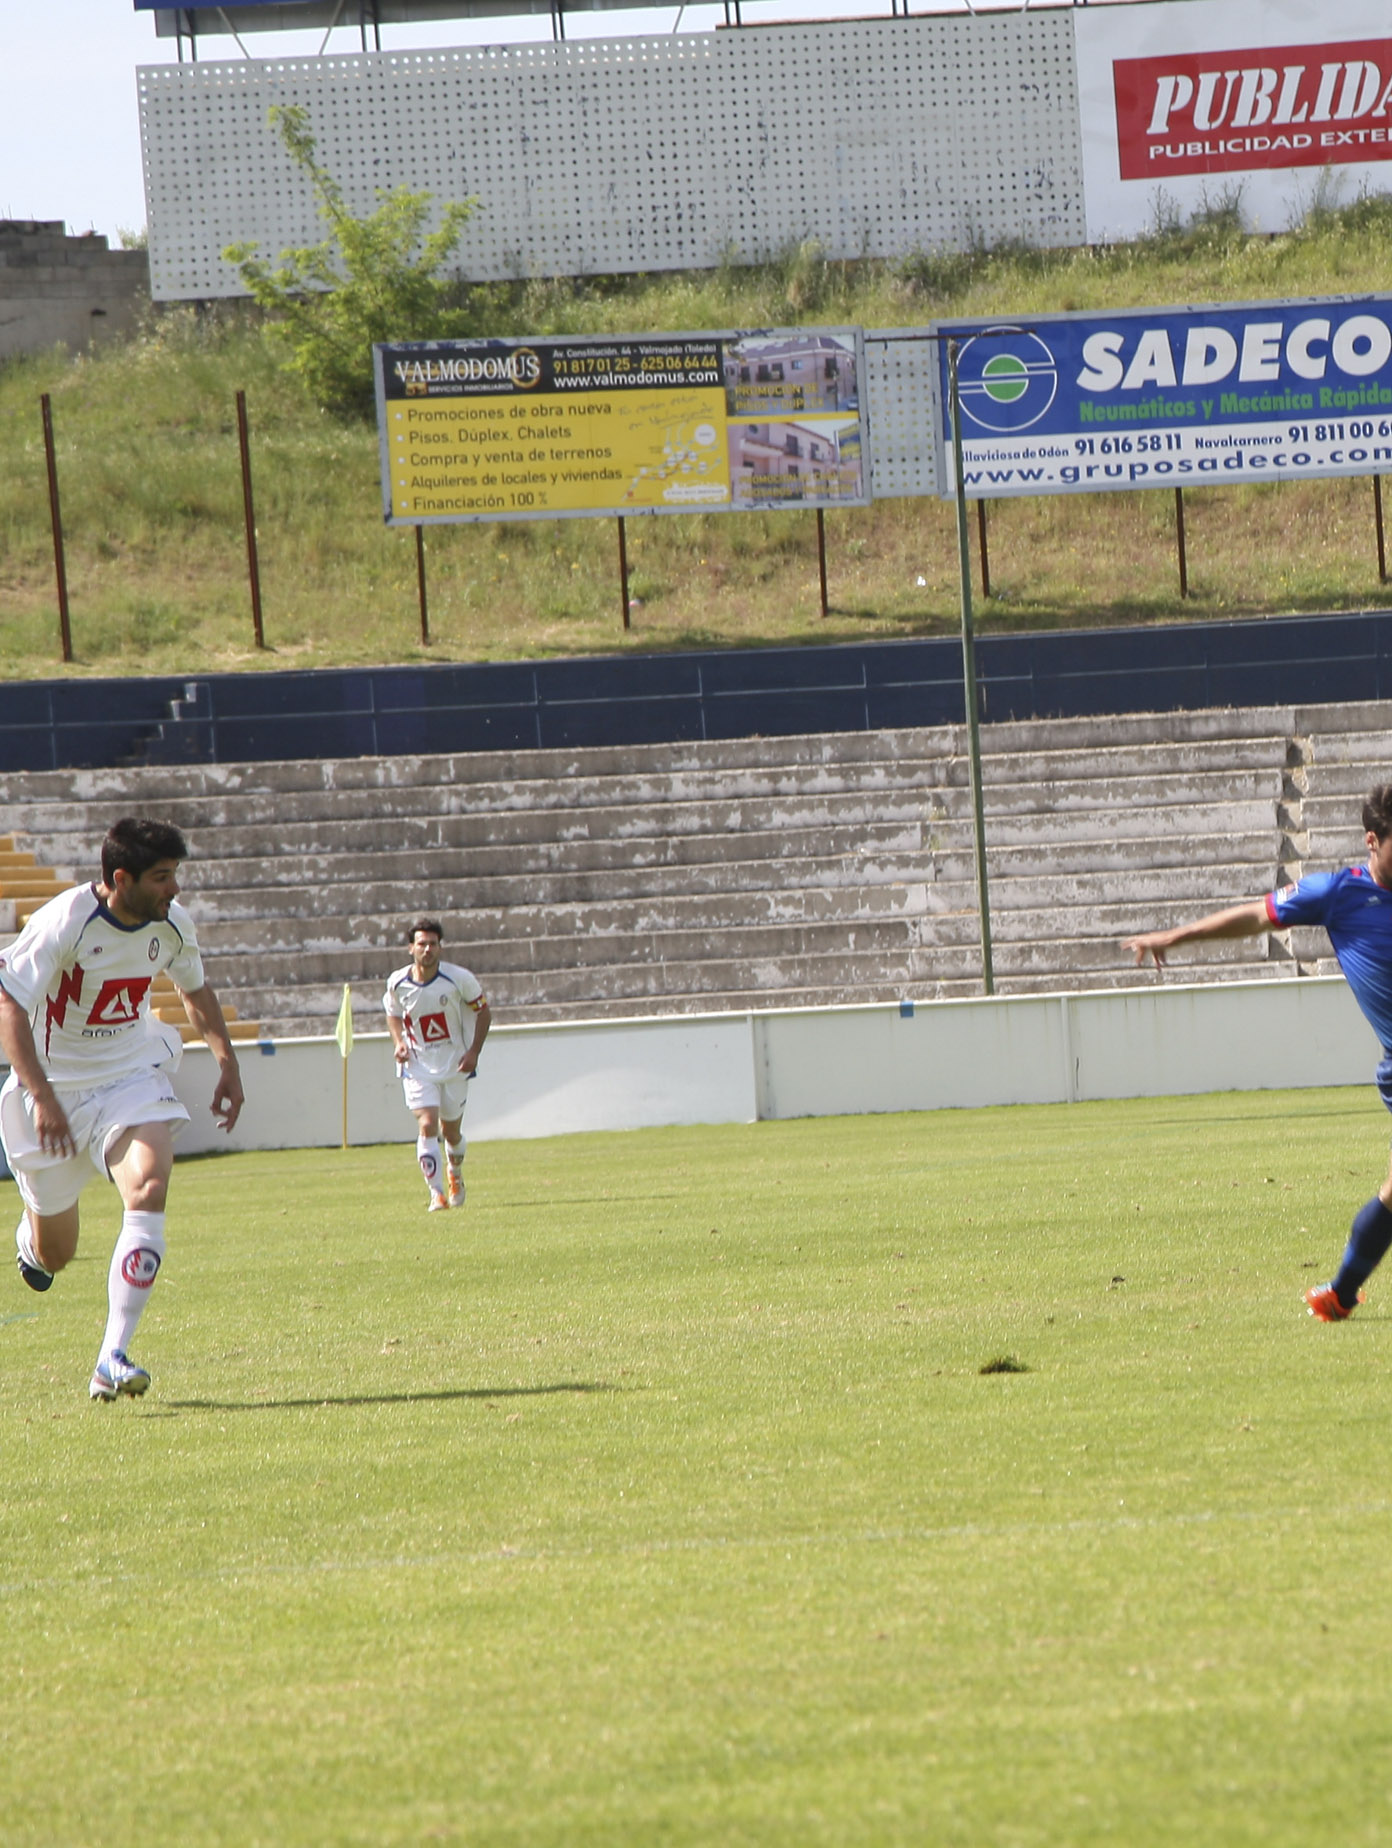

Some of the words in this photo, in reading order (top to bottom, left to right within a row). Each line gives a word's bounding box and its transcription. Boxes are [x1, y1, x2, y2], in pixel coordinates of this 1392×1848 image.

[1149, 134, 1312, 160] PUBLICIDAD
[553, 360, 568, 374] 91
[571, 358, 595, 373] 817
[596, 358, 611, 373] 01
[614, 357, 631, 372] 25
[641, 356, 665, 371] 625
[666, 355, 682, 371] 06
[684, 355, 700, 369] 64
[701, 354, 717, 368] 44
[1075, 314, 1392, 393] SADECO
[396, 355, 541, 383] VALMODOMUS
[553, 370, 718, 388] www.valmodomus.com
[408, 407, 504, 422] Promociones
[509, 405, 526, 419] de
[531, 404, 563, 418] obra
[568, 402, 611, 416] nueva
[1079, 396, 1196, 423] Neumáticos
[1201, 398, 1214, 420] y
[1220, 389, 1314, 415] Mecánica
[1319, 381, 1392, 410] Rápida
[518, 425, 572, 440] Chalets
[1022, 448, 1036, 460] de
[1038, 445, 1069, 459] Odón
[1074, 438, 1095, 456] 91
[1100, 436, 1133, 455] 616
[1137, 434, 1162, 453] 58
[1167, 433, 1182, 451] 11
[1195, 435, 1282, 449] Navalcarnero
[1288, 425, 1309, 443] 91
[1315, 423, 1344, 442] 811
[1349, 421, 1374, 439] 00
[410, 452, 468, 471] Compra
[473, 453, 480, 467] y
[485, 449, 524, 464] venta
[528, 448, 546, 461] de
[550, 446, 612, 460] terrenos
[411, 473, 477, 491] Alquileres
[481, 471, 498, 486] de
[501, 469, 547, 484] locales
[551, 470, 559, 484] y
[561, 466, 622, 482] viviendas
[413, 493, 505, 511] Financiación
[510, 492, 534, 506] 100
